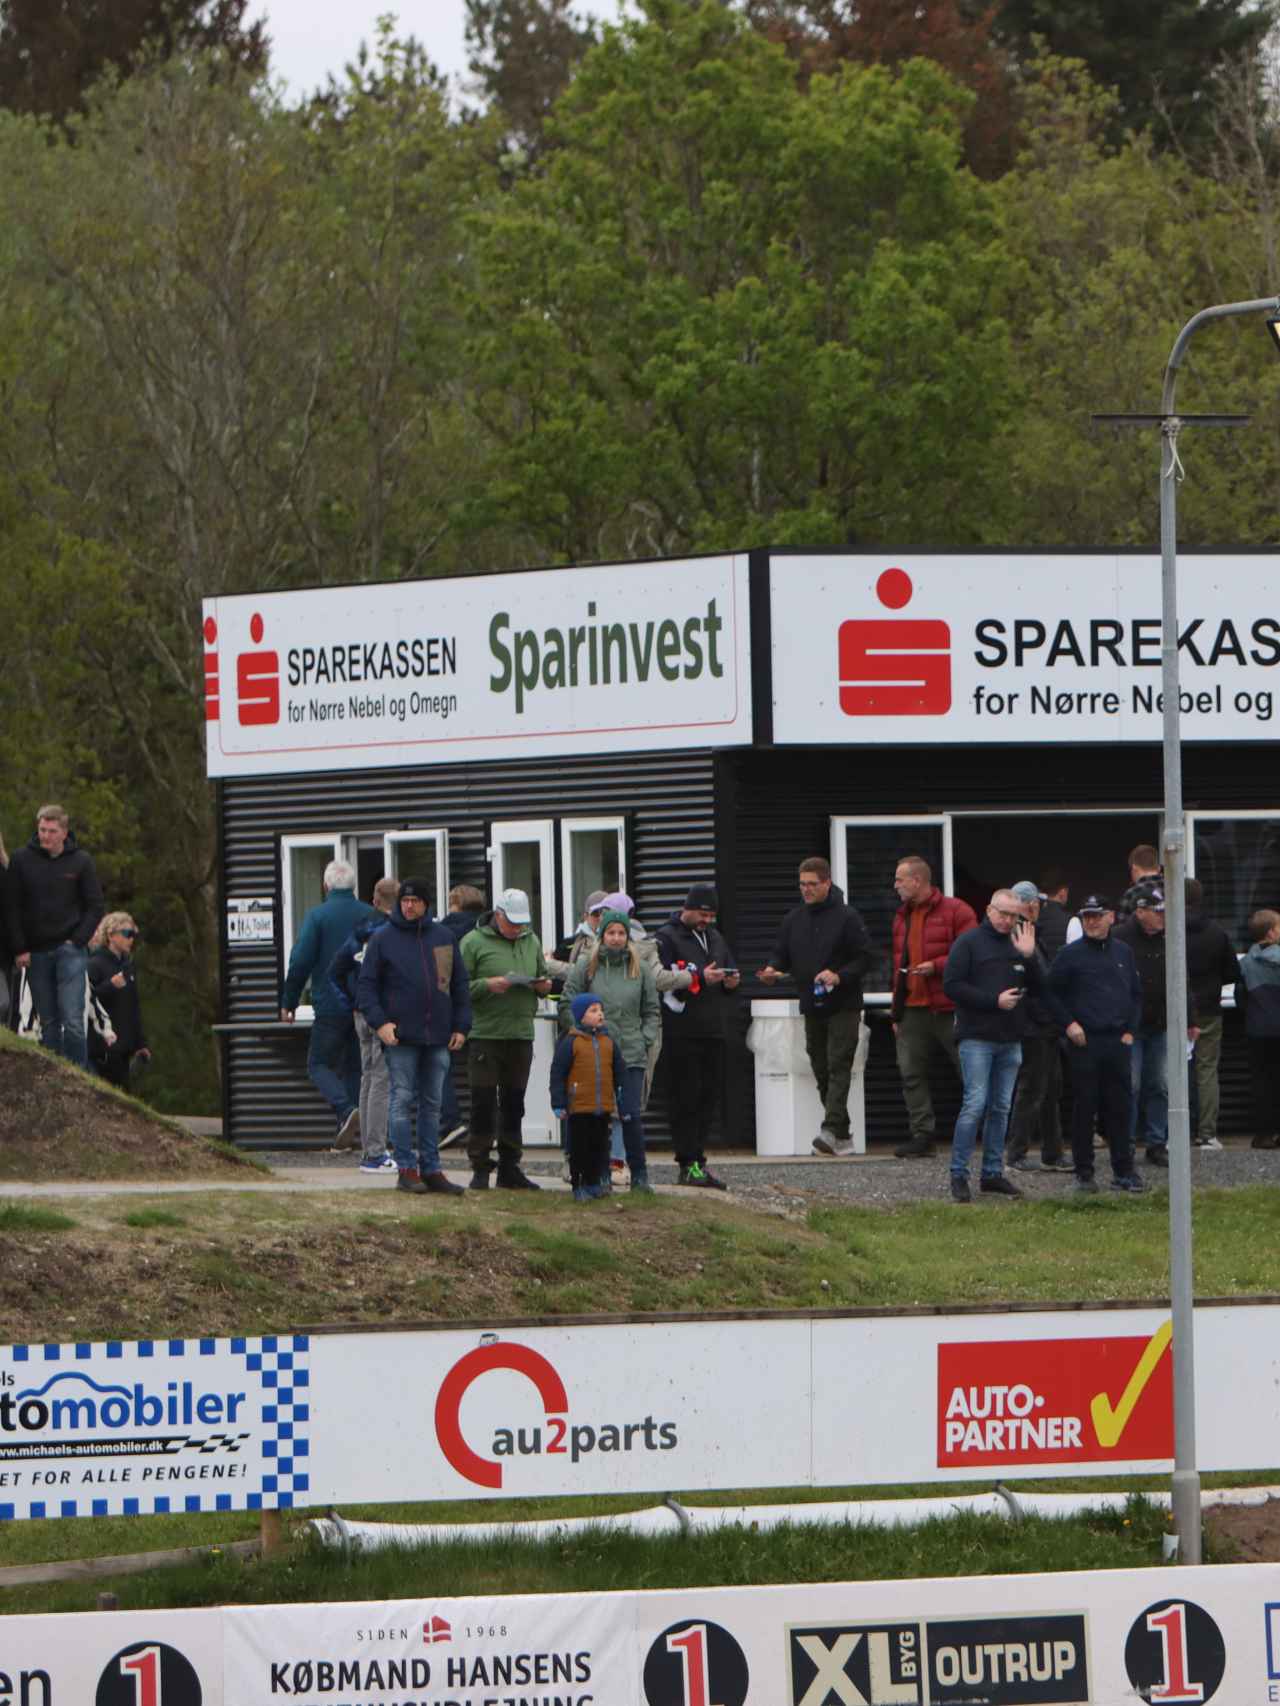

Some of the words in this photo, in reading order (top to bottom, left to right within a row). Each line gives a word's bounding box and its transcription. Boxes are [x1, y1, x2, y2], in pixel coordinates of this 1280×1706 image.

[287, 637, 457, 686] SPAREKASSEN
[488, 597, 724, 713] Sparinvest
[288, 700, 306, 723] for
[310, 698, 345, 721] Nørre
[349, 694, 386, 719] Nebel
[389, 698, 406, 722] og
[410, 691, 457, 719] Omegn
[973, 685, 1018, 714] for
[1030, 685, 1121, 714] Nørre
[1233, 691, 1273, 720] og
[0, 1370, 15, 1386] ls
[491, 1414, 678, 1463] au2parts
[945, 1416, 1084, 1453] PARTNER
[32, 1470, 71, 1486] FOR
[81, 1467, 132, 1484] ALLE
[142, 1463, 248, 1482] PENGENE!
[356, 1629, 409, 1641] SIDEN
[466, 1625, 509, 1638] 1968
[1146, 1603, 1204, 1704] 1
[119, 1646, 162, 1706] 1
[271, 1657, 432, 1695] KØBMAND
[446, 1651, 593, 1688] HANSENS
[666, 1624, 725, 1706] 1
[795, 1631, 920, 1706] XL
[899, 1630, 916, 1677] BYG
[935, 1640, 1077, 1687] OUTRUP
